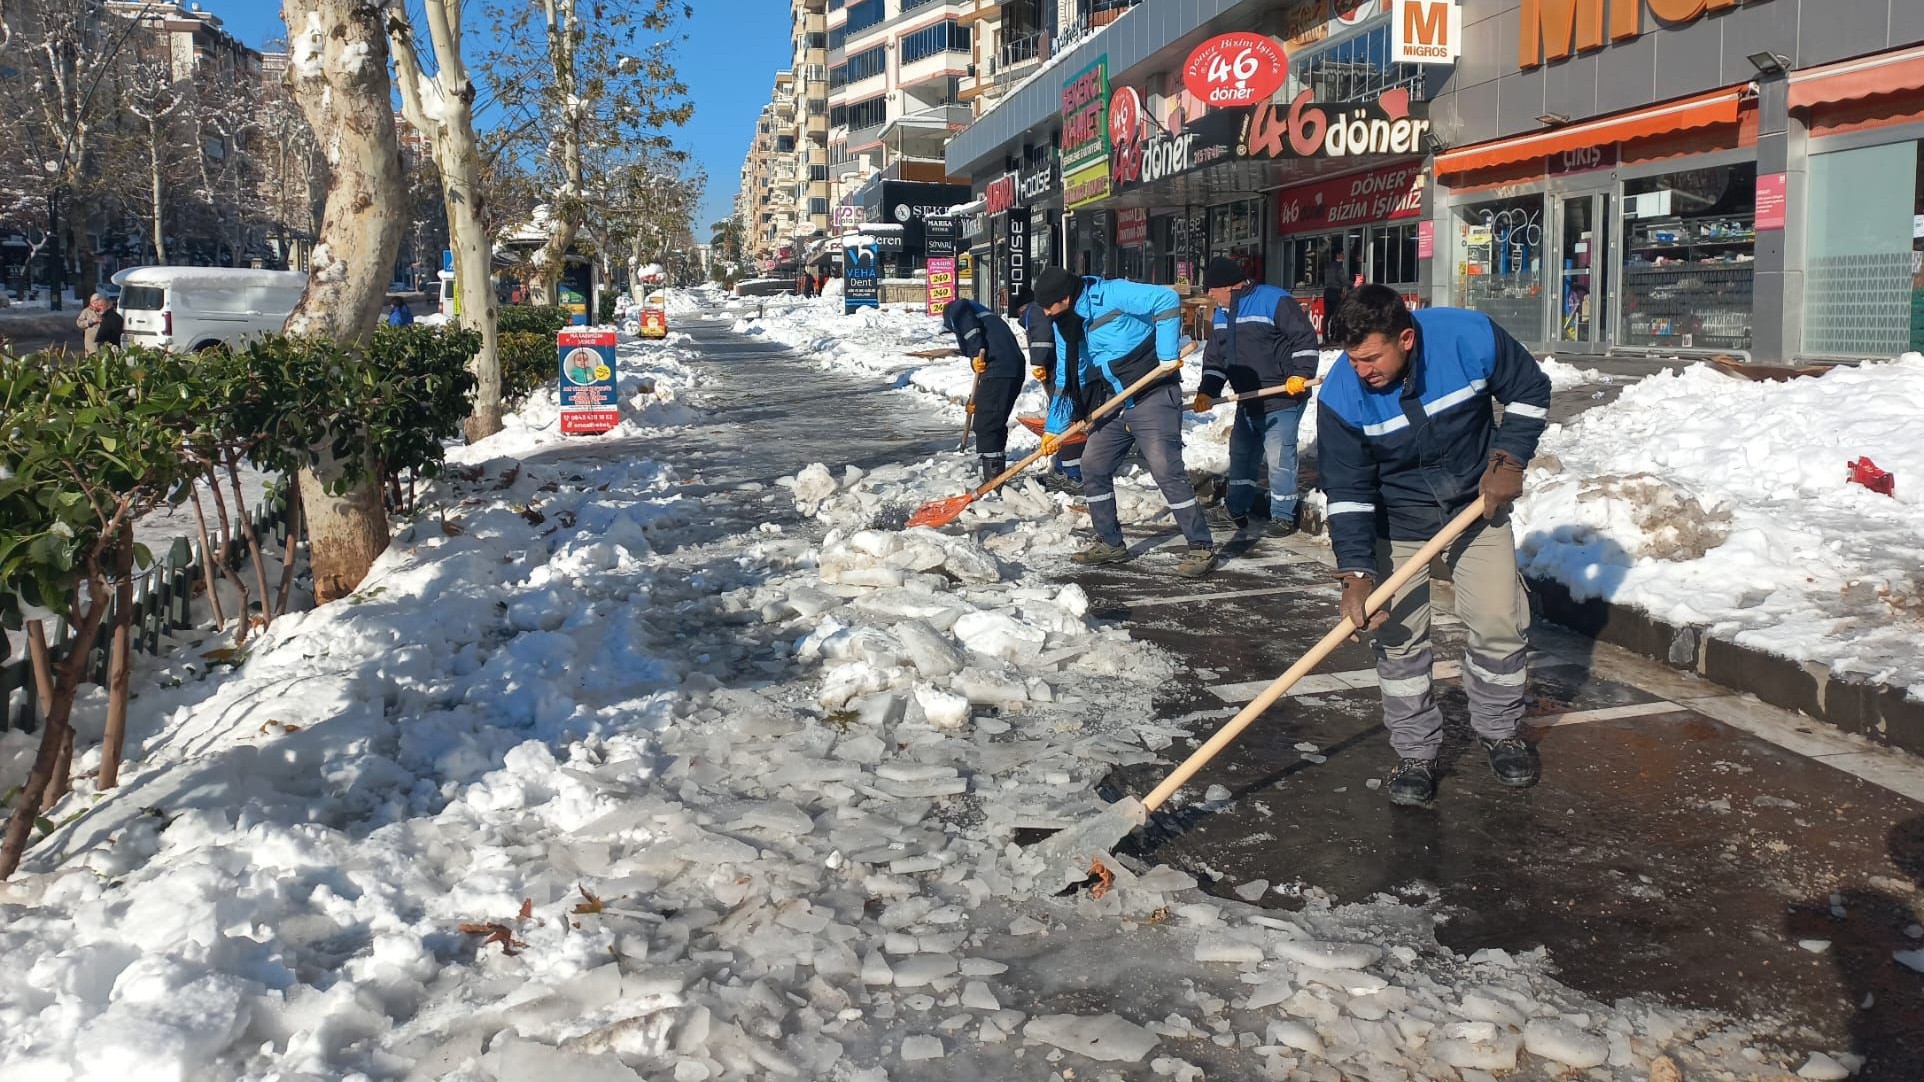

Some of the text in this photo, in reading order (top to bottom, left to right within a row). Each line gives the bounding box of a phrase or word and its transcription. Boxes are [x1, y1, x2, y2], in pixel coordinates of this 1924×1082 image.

[1404, 1, 1447, 45] M
[1207, 48, 1258, 82] 46
[1209, 86, 1255, 101] döner
[1249, 88, 1327, 158] 46
[1325, 108, 1429, 157] döner
[1142, 131, 1193, 183] döner
[1350, 172, 1407, 197] DÖNER
[1281, 199, 1300, 224] 46
[1328, 190, 1422, 222] BİZİM İŞİMİZ
[1479, 208, 1541, 246] 2026
[847, 268, 876, 278] VEHA
[850, 278, 872, 287] Dent
